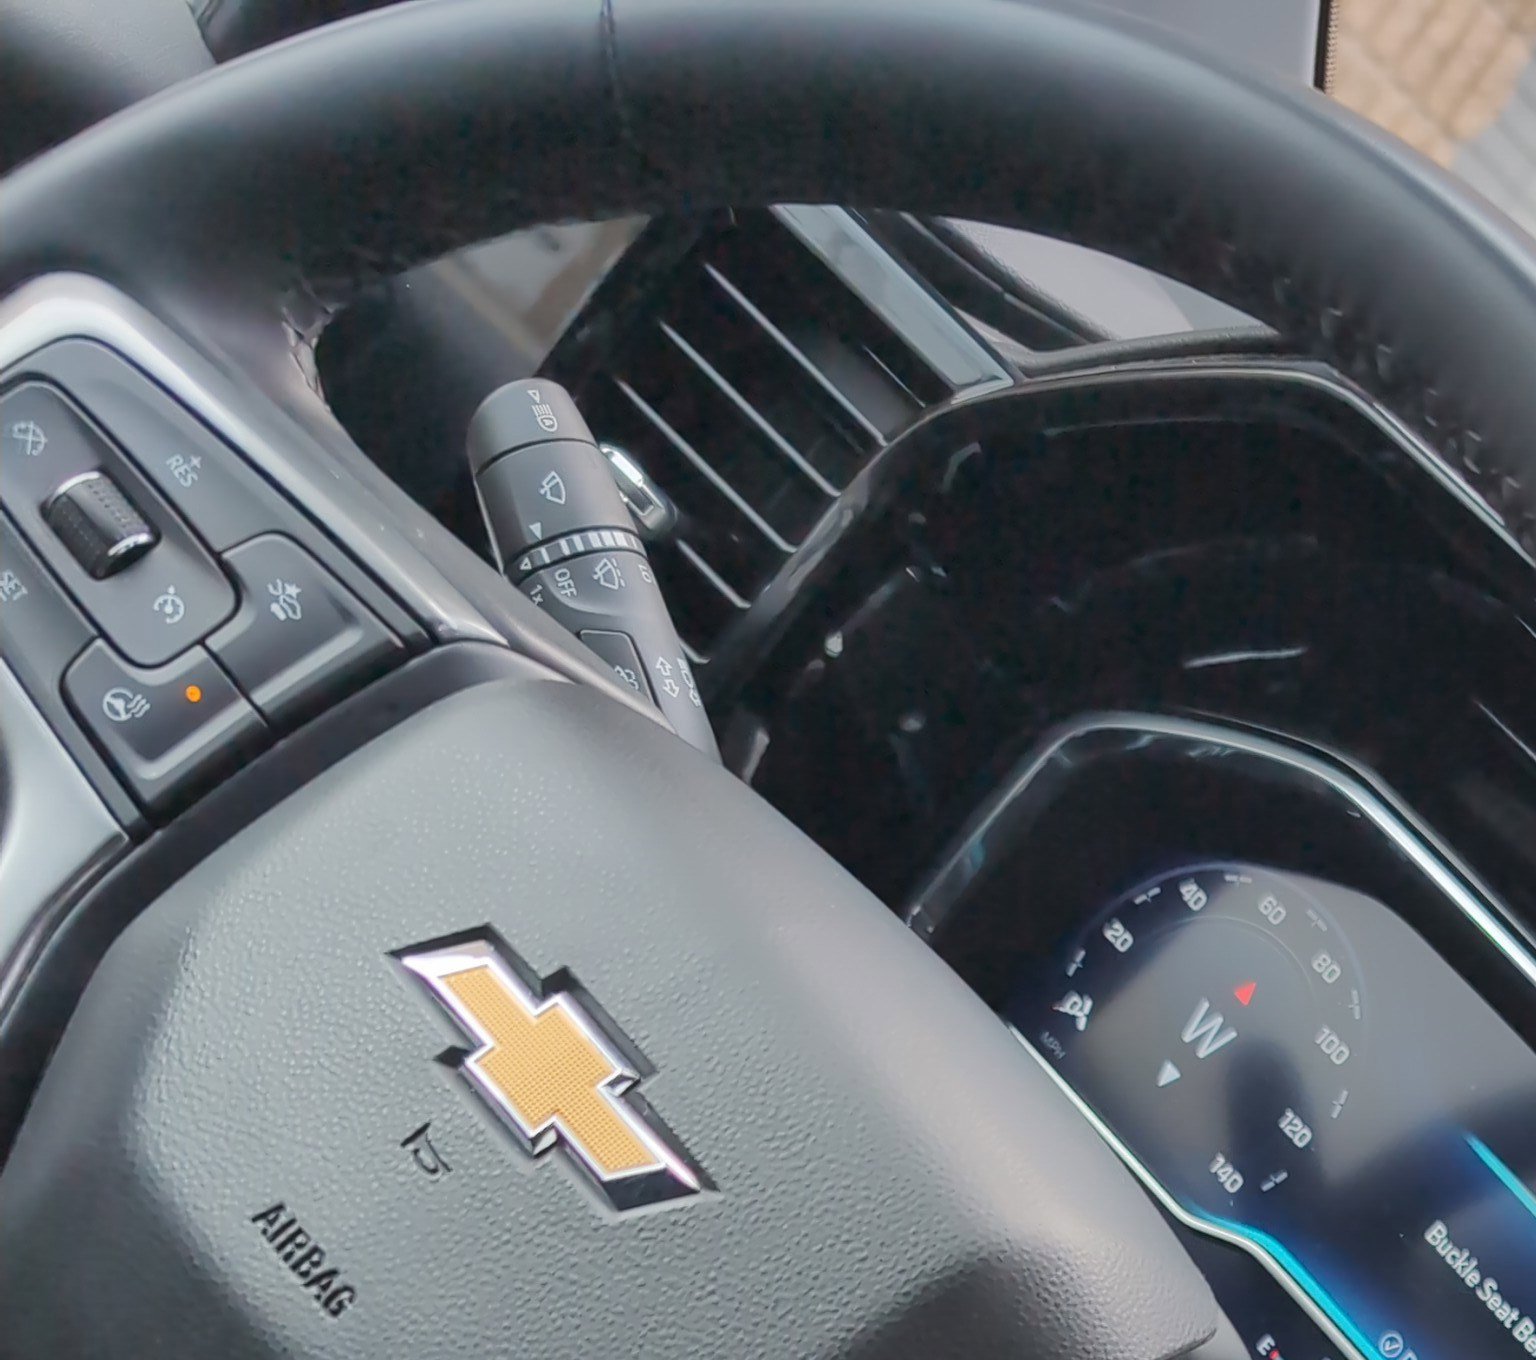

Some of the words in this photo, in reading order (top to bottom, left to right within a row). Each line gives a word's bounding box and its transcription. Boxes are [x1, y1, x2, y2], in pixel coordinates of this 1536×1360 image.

[554, 568, 577, 598] OFF
[1179, 877, 1208, 911] 40
[1257, 895, 1287, 926] 60
[1103, 917, 1134, 952] 20
[1311, 953, 1342, 984] 80
[1181, 995, 1238, 1059] W
[1315, 1025, 1350, 1065] 100
[1278, 1107, 1312, 1148] 120
[1209, 1152, 1244, 1194] 140
[251, 1202, 356, 1318] AIRBAG
[1423, 1219, 1481, 1289] Buckle
[1475, 1276, 1520, 1330] Seat
[1256, 1333, 1276, 1357] E
